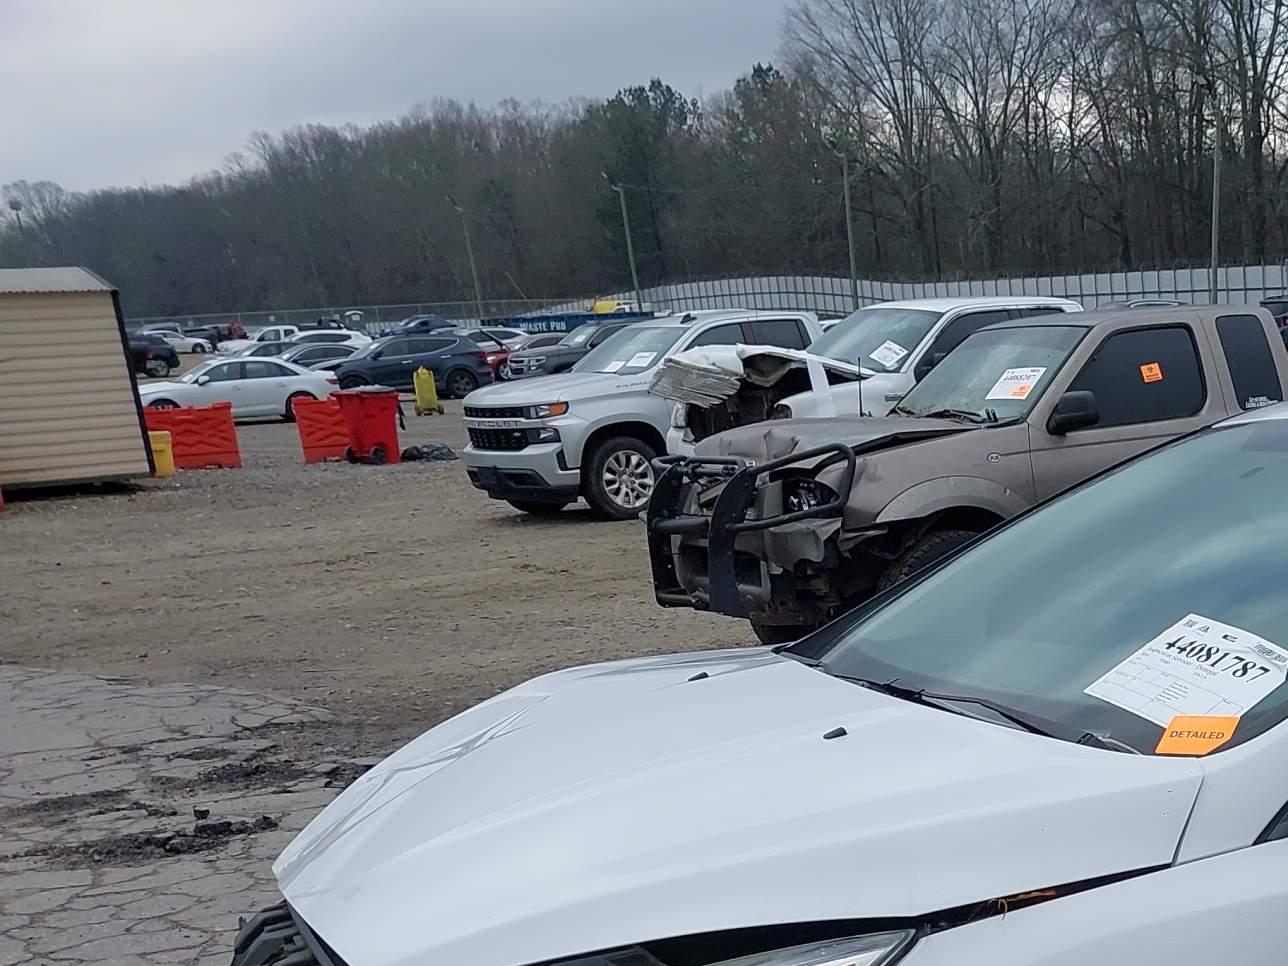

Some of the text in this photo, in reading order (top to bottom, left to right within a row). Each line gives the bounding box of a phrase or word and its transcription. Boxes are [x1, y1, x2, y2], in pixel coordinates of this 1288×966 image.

[520, 322, 547, 332] WASTE
[1165, 635, 1271, 683] 44081787
[1169, 730, 1225, 739] DETAILED
